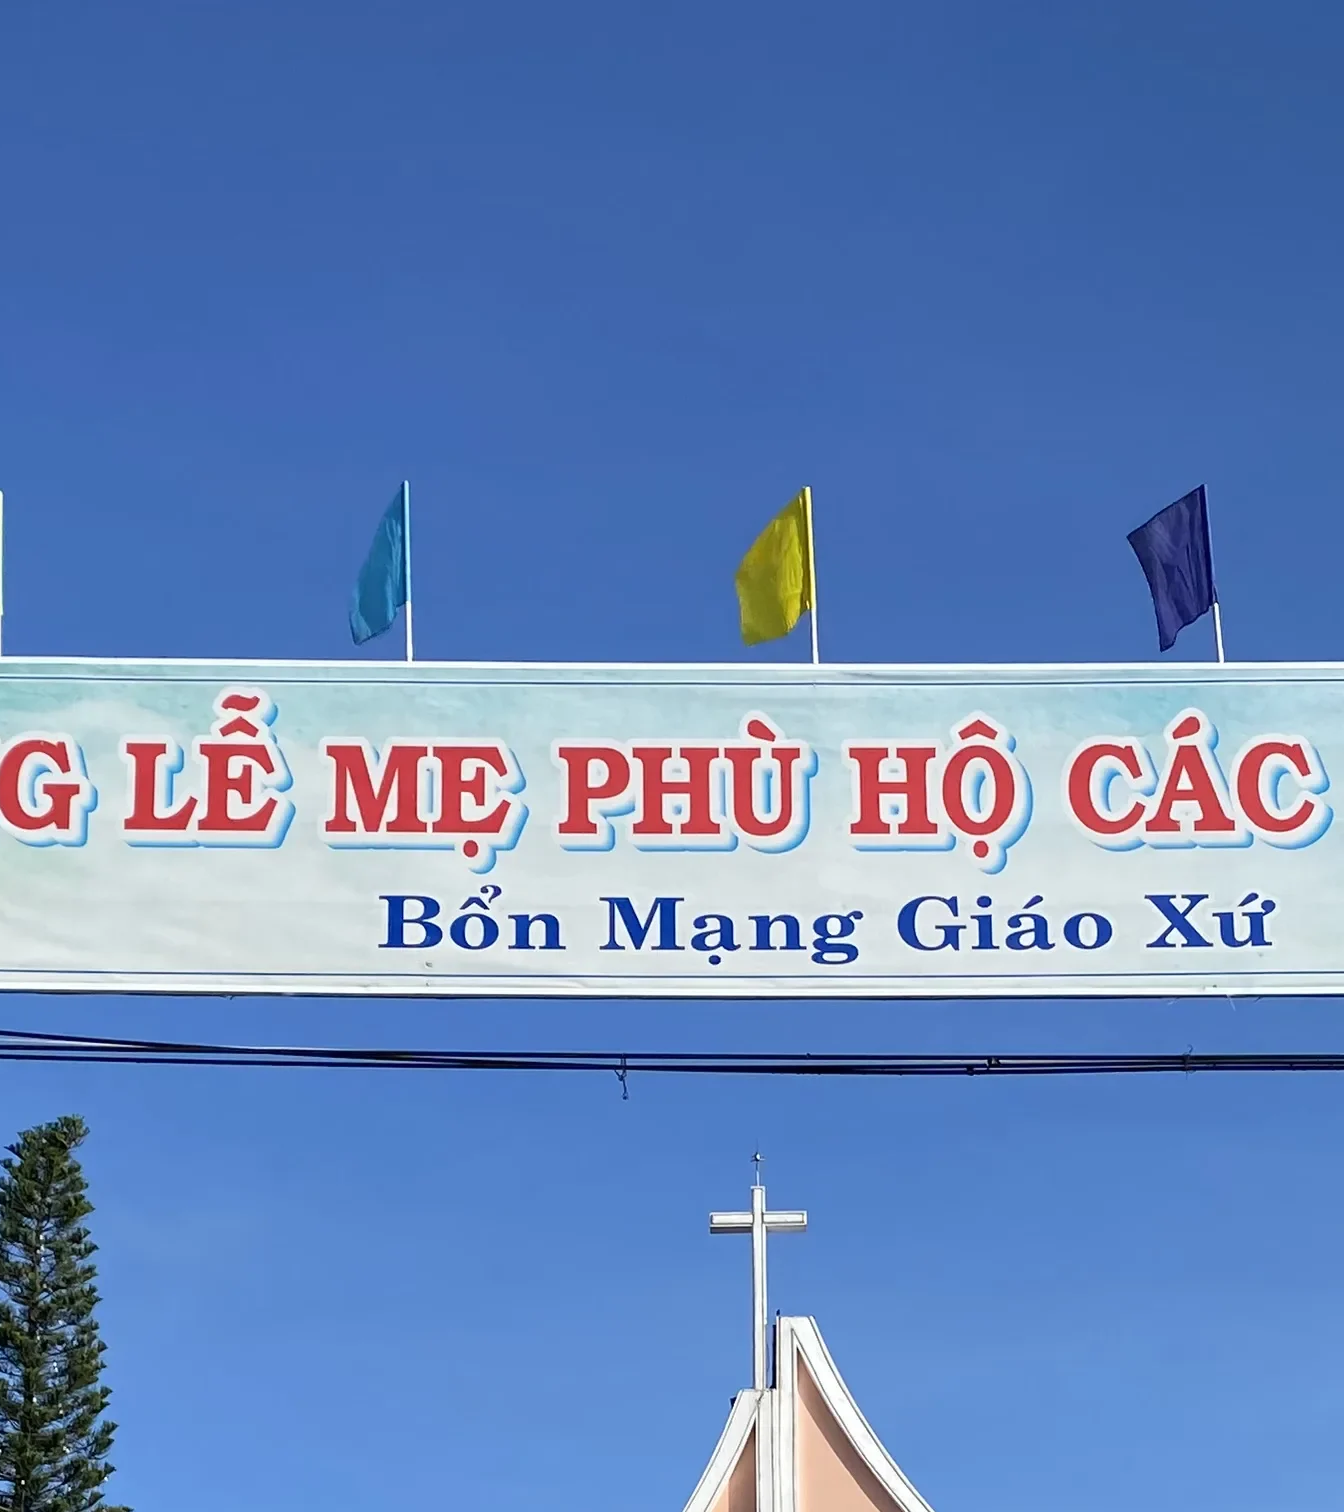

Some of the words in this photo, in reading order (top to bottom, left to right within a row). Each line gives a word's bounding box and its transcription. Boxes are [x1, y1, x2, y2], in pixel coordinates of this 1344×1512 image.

[125, 695, 276, 831] LỄ
[326, 746, 510, 857] MẸ
[559, 721, 800, 836] PHÙ
[849, 725, 1014, 857] HỘ
[1069, 717, 1313, 834] CÁC
[384, 886, 561, 949] Bổn
[605, 898, 862, 965] Mạng
[898, 896, 1112, 950] Giáo
[1148, 893, 1275, 947] Xứ
